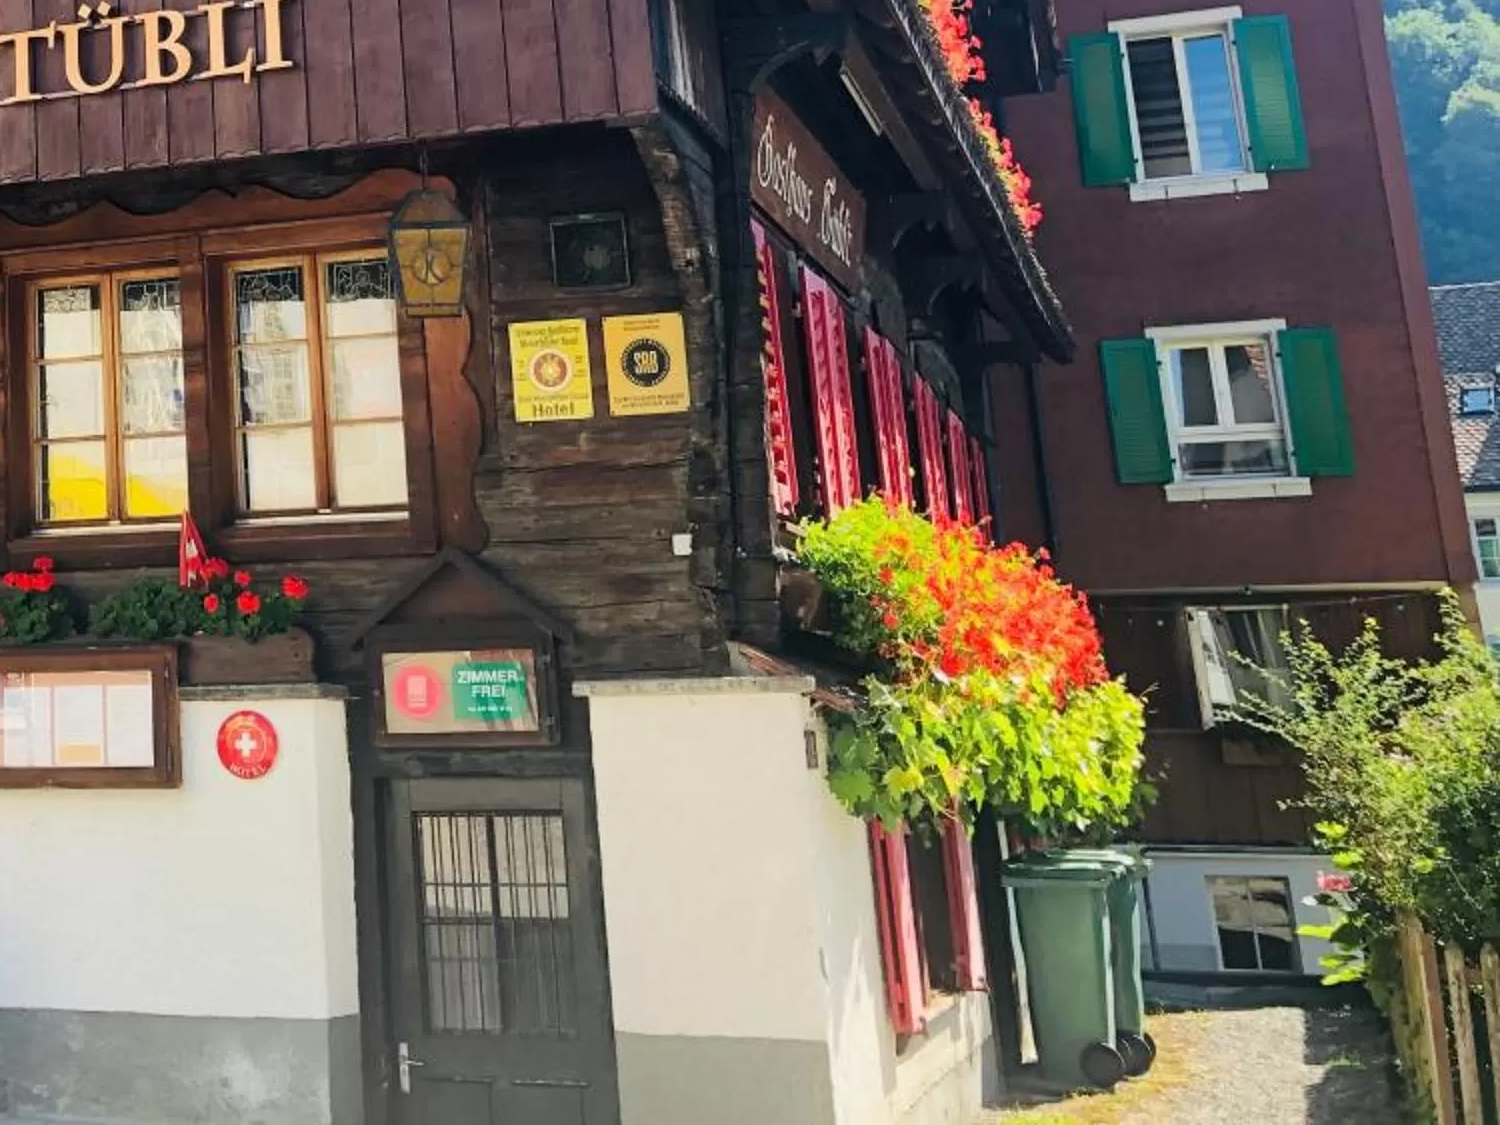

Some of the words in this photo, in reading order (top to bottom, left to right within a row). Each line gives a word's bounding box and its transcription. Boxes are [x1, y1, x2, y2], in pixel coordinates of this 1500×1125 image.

[532, 401, 575, 418] Hotel
[457, 669, 519, 684] ZIMMER
[471, 684, 506, 698] FREI
[229, 761, 267, 779] HOTEL
